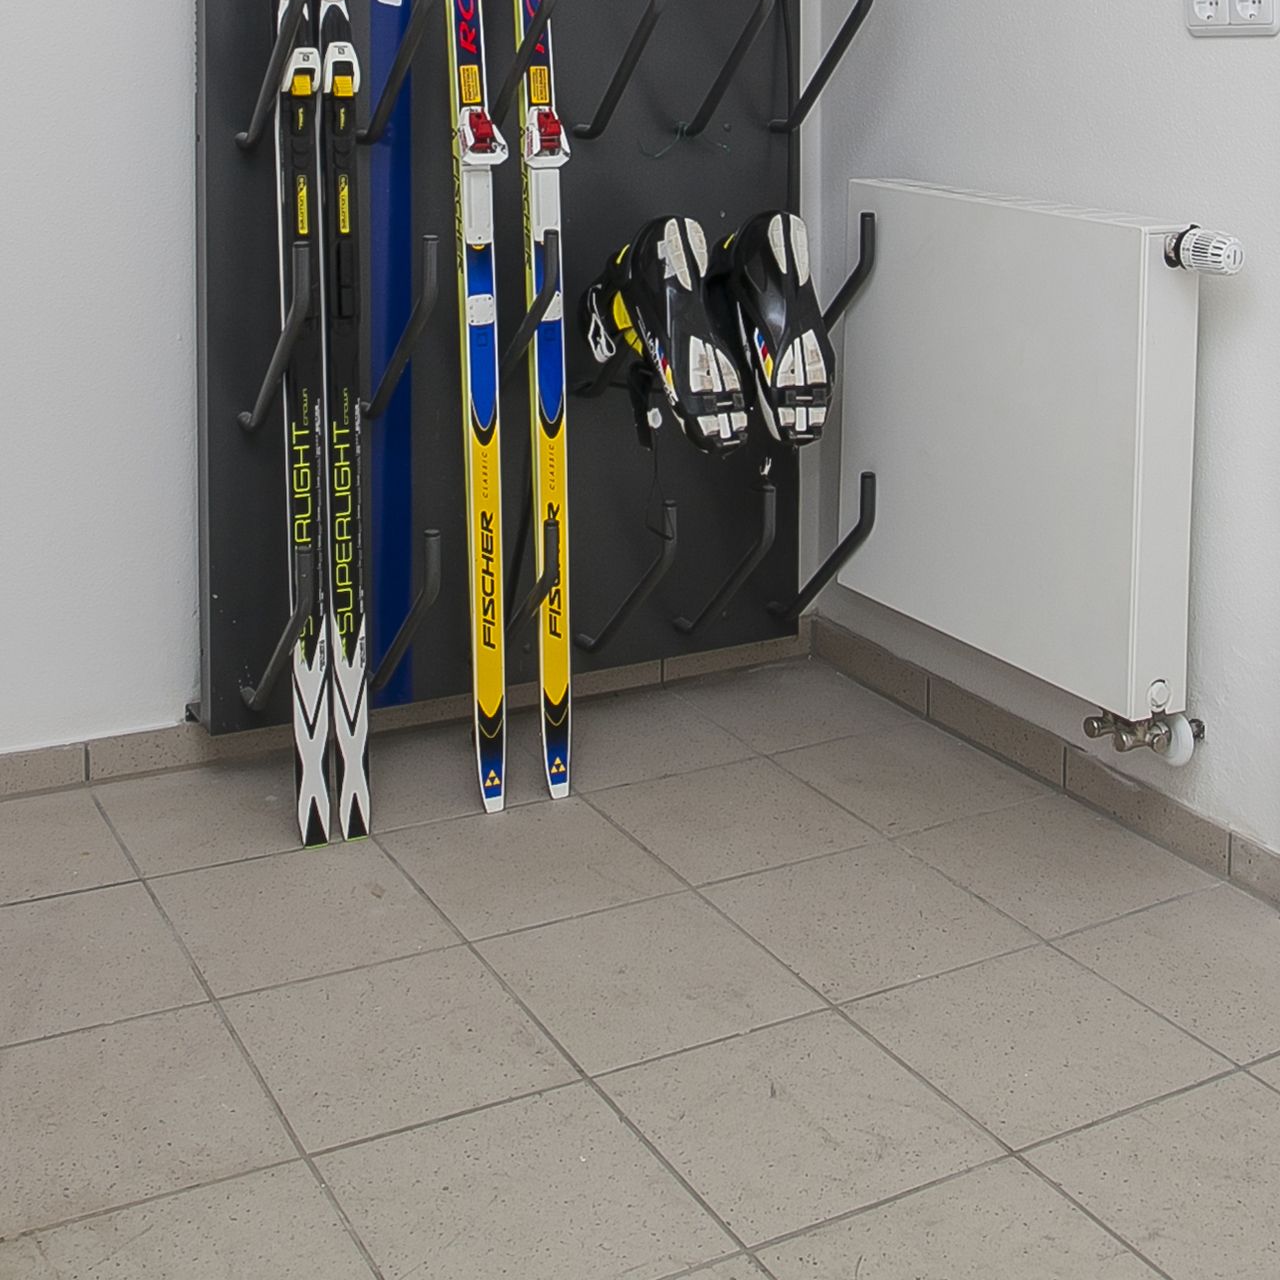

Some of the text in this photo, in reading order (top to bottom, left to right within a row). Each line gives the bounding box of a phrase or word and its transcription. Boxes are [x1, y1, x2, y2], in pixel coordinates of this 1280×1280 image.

[333, 421, 353, 633] SUPERLIGHT
[481, 451, 489, 499] CLASSIC
[480, 510, 496, 650] FISCHER
[547, 502, 562, 639] FISR
